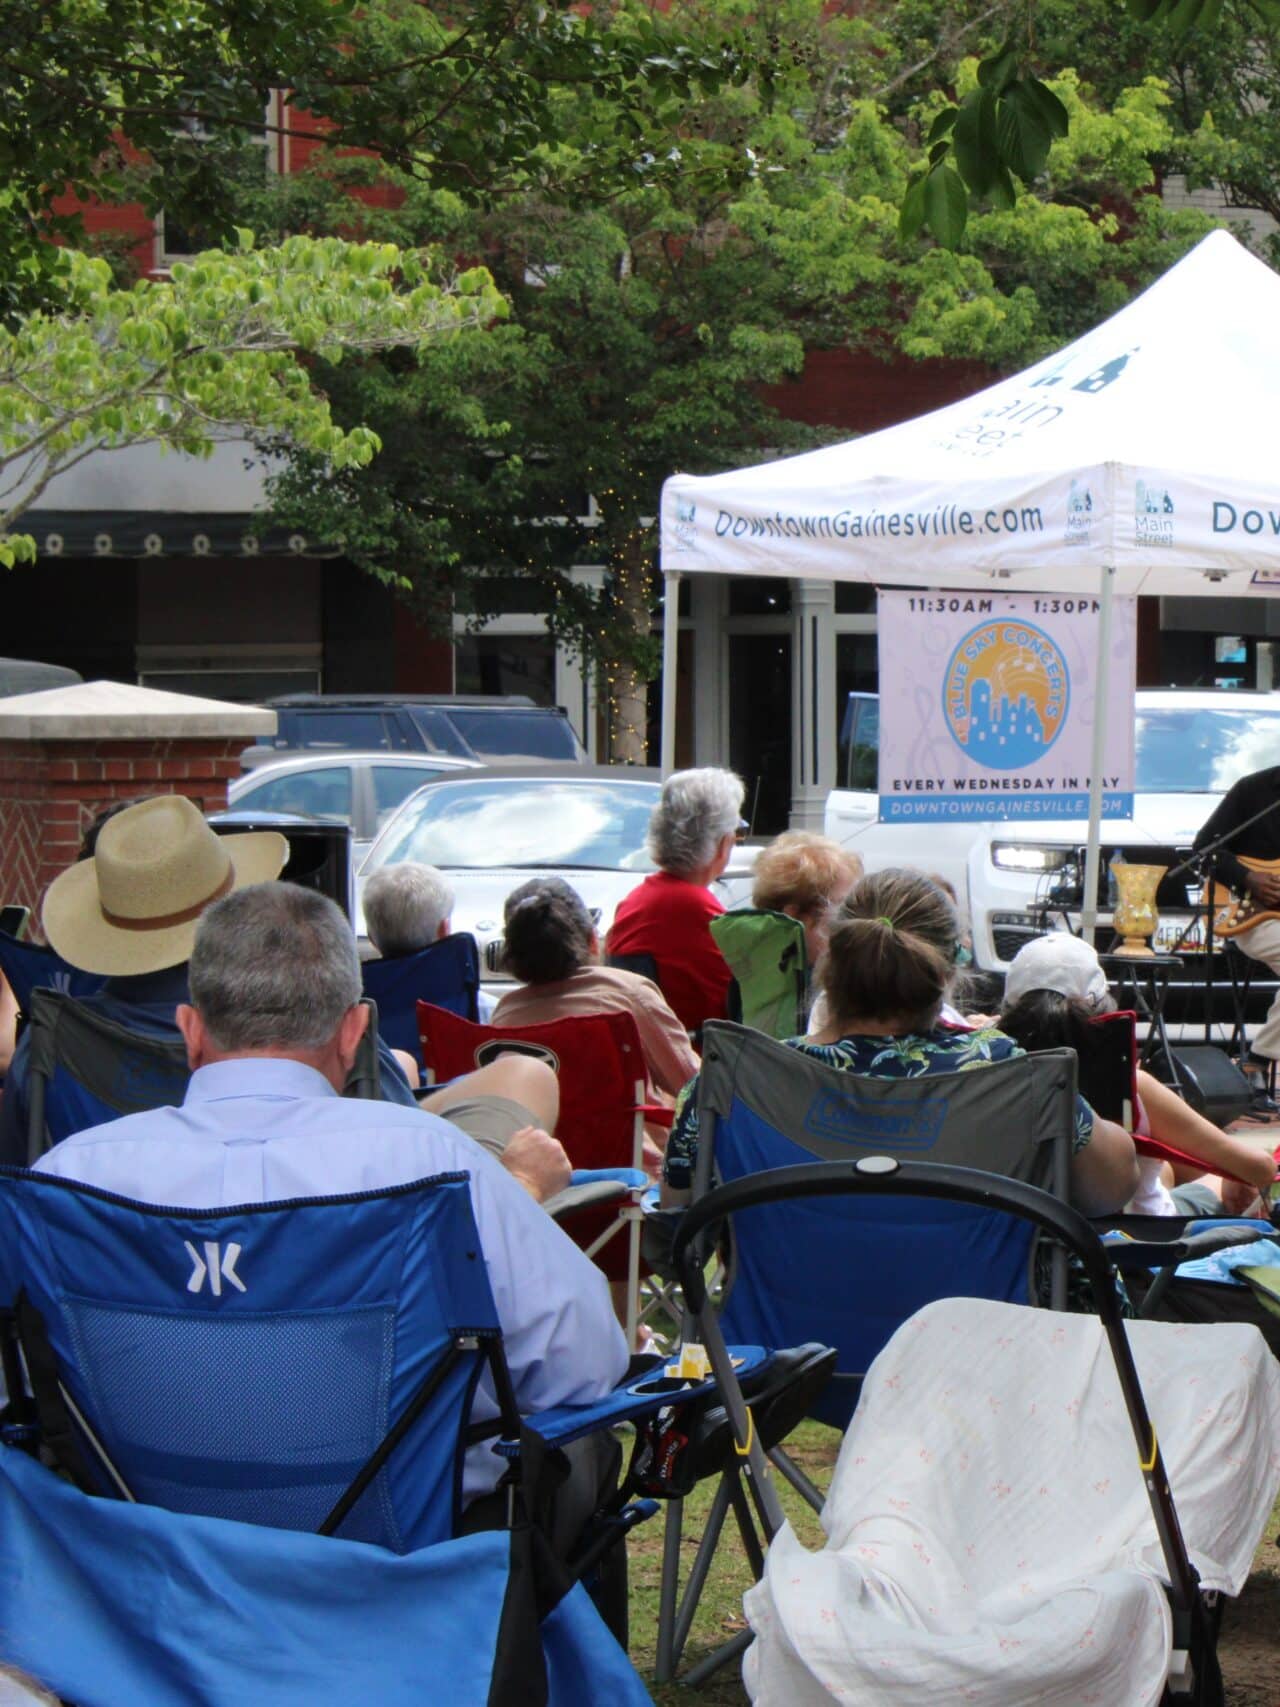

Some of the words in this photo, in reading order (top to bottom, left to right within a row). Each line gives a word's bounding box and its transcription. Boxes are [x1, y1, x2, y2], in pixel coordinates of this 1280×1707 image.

[714, 503, 1044, 538] DowntownGainesville.com
[1135, 515, 1174, 532] Main
[1135, 532, 1175, 547] Street
[908, 598, 993, 613] 11:30AM
[952, 663, 968, 719] BLUE
[965, 630, 997, 660] SKY
[1004, 628, 1062, 718] CONCERTS
[893, 779, 945, 790] EVERY
[953, 778, 1055, 790] WEDNESDAY
[1062, 778, 1079, 789] IN
[1086, 777, 1120, 788] AY
[891, 799, 1122, 815] DOWNTOWNGAINESVILLE.OM
